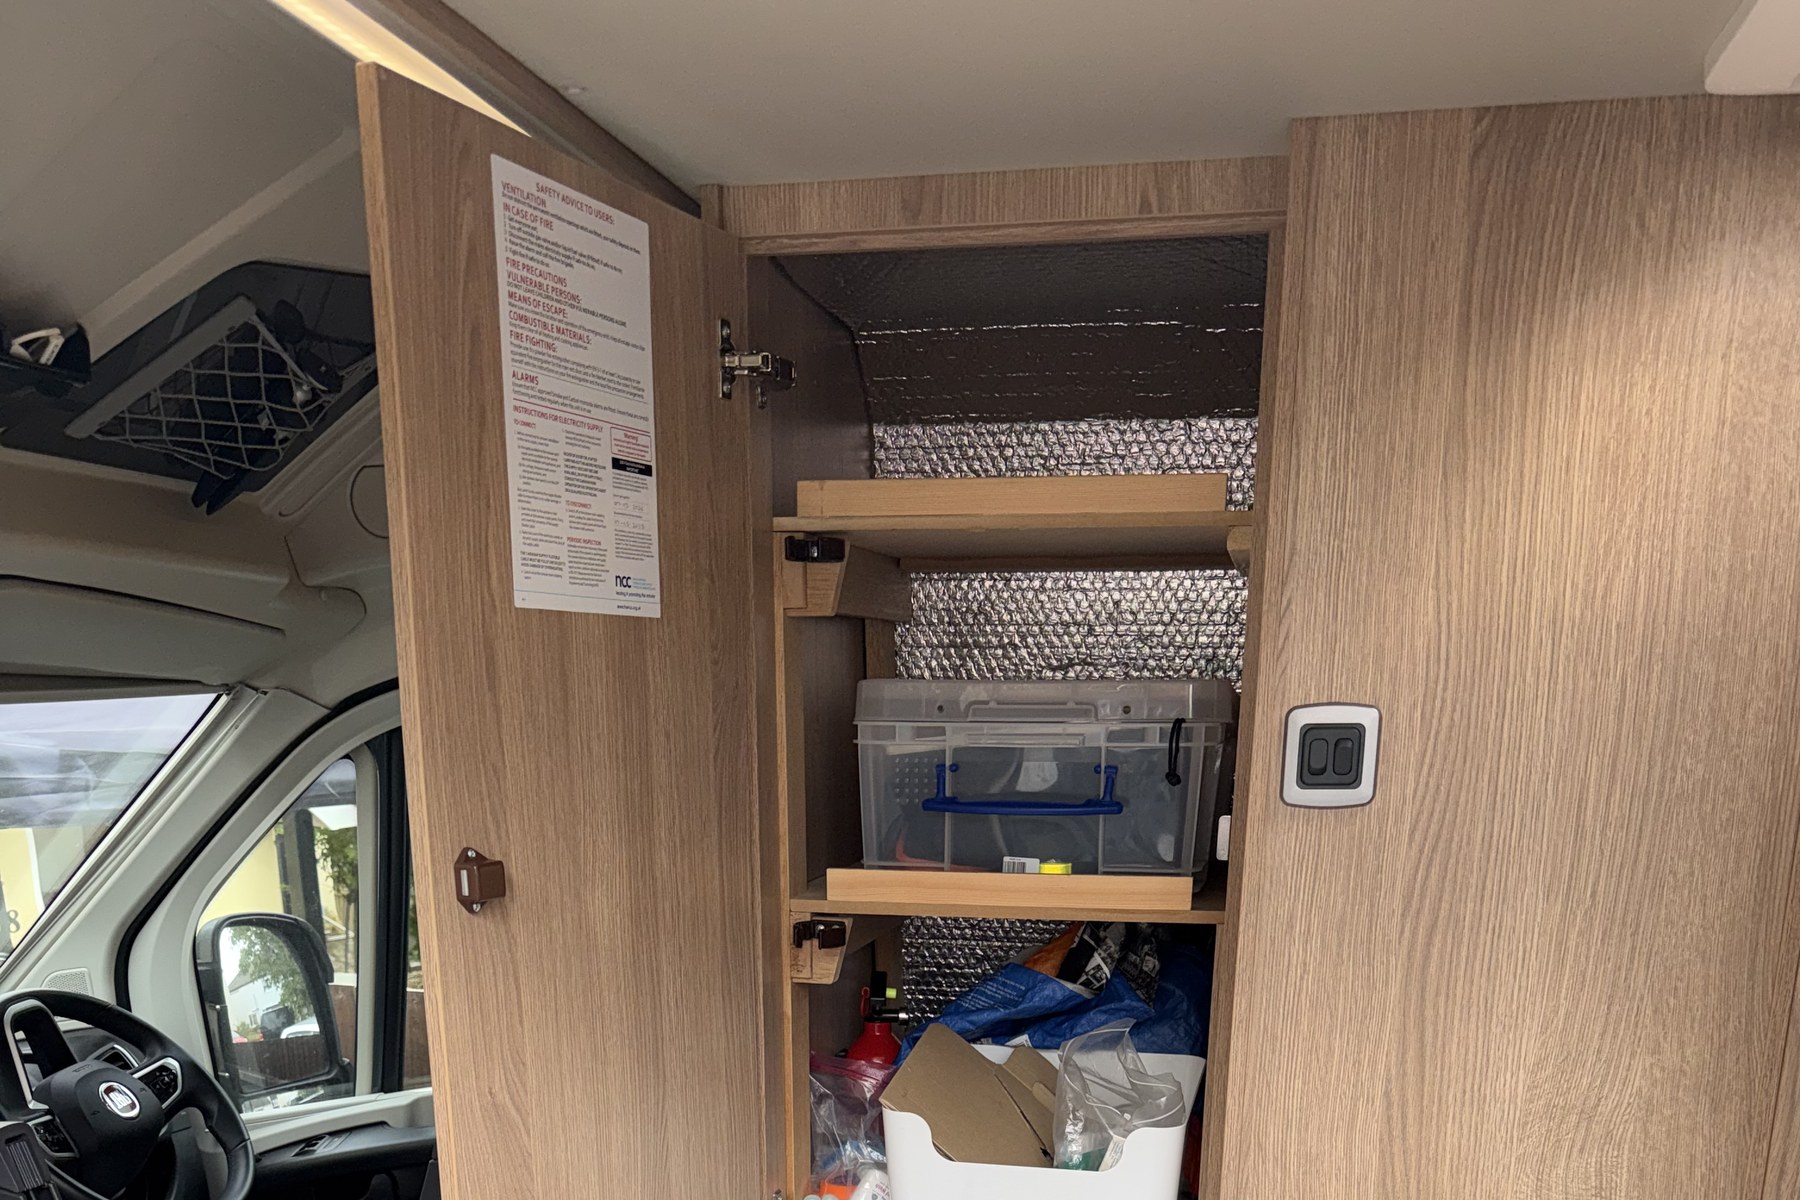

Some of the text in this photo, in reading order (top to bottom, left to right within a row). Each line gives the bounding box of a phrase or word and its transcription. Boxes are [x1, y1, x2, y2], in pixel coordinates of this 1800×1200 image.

[502, 181, 546, 209] VENTILATION
[536, 182, 615, 226] SAFETY ADVICE TO USERS:
[503, 202, 554, 232] IN CASE OF FIRE
[506, 257, 520, 271] FIRE
[522, 263, 567, 288] PRECAUTIONS
[507, 270, 582, 306] VULNERABLE PERSONS:
[508, 290, 568, 319] MEANS OF ESCAPE:
[509, 310, 554, 334] COMBUSTIBLE
[556, 326, 592, 346] MATERIALS:
[510, 330, 524, 343] FIRE
[526, 335, 557, 353] FIGHTING:
[512, 370, 539, 386] ALARMS
[513, 405, 603, 434] INSTRUCTIONS FOR ELECTRICITY SUPPLY
[615, 575, 632, 588] ncc
